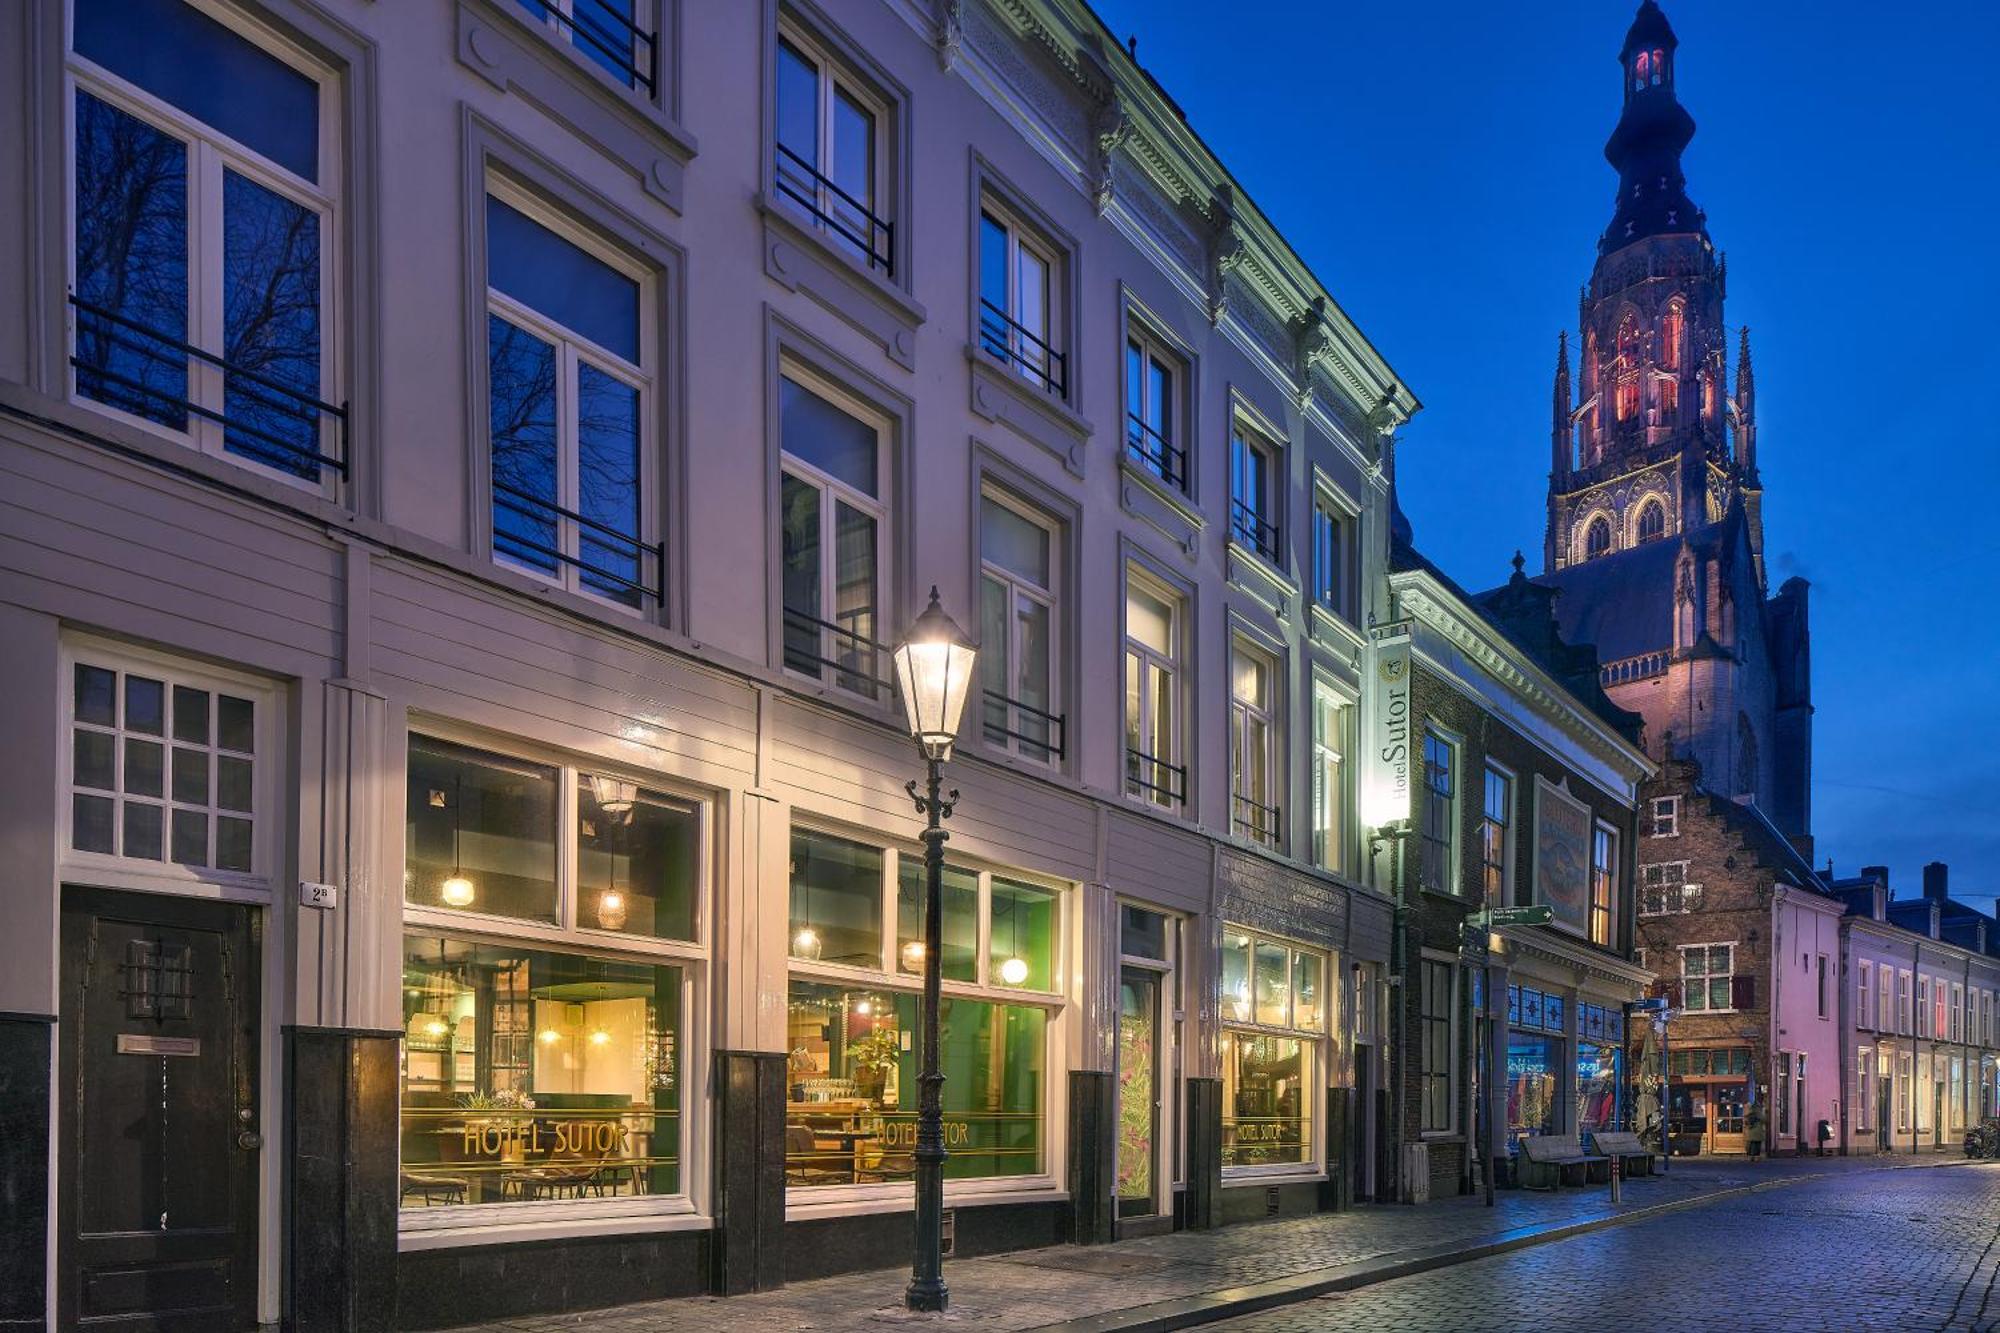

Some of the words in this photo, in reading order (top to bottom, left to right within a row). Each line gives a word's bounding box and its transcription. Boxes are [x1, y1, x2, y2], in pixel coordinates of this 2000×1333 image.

[1382, 689, 1406, 762] Sutor
[1392, 763, 1406, 800] Hotel
[313, 887, 328, 902] 2B
[464, 1123, 545, 1155] HOTEL
[554, 1122, 630, 1152] SUTOR
[941, 1122, 968, 1145] TOR
